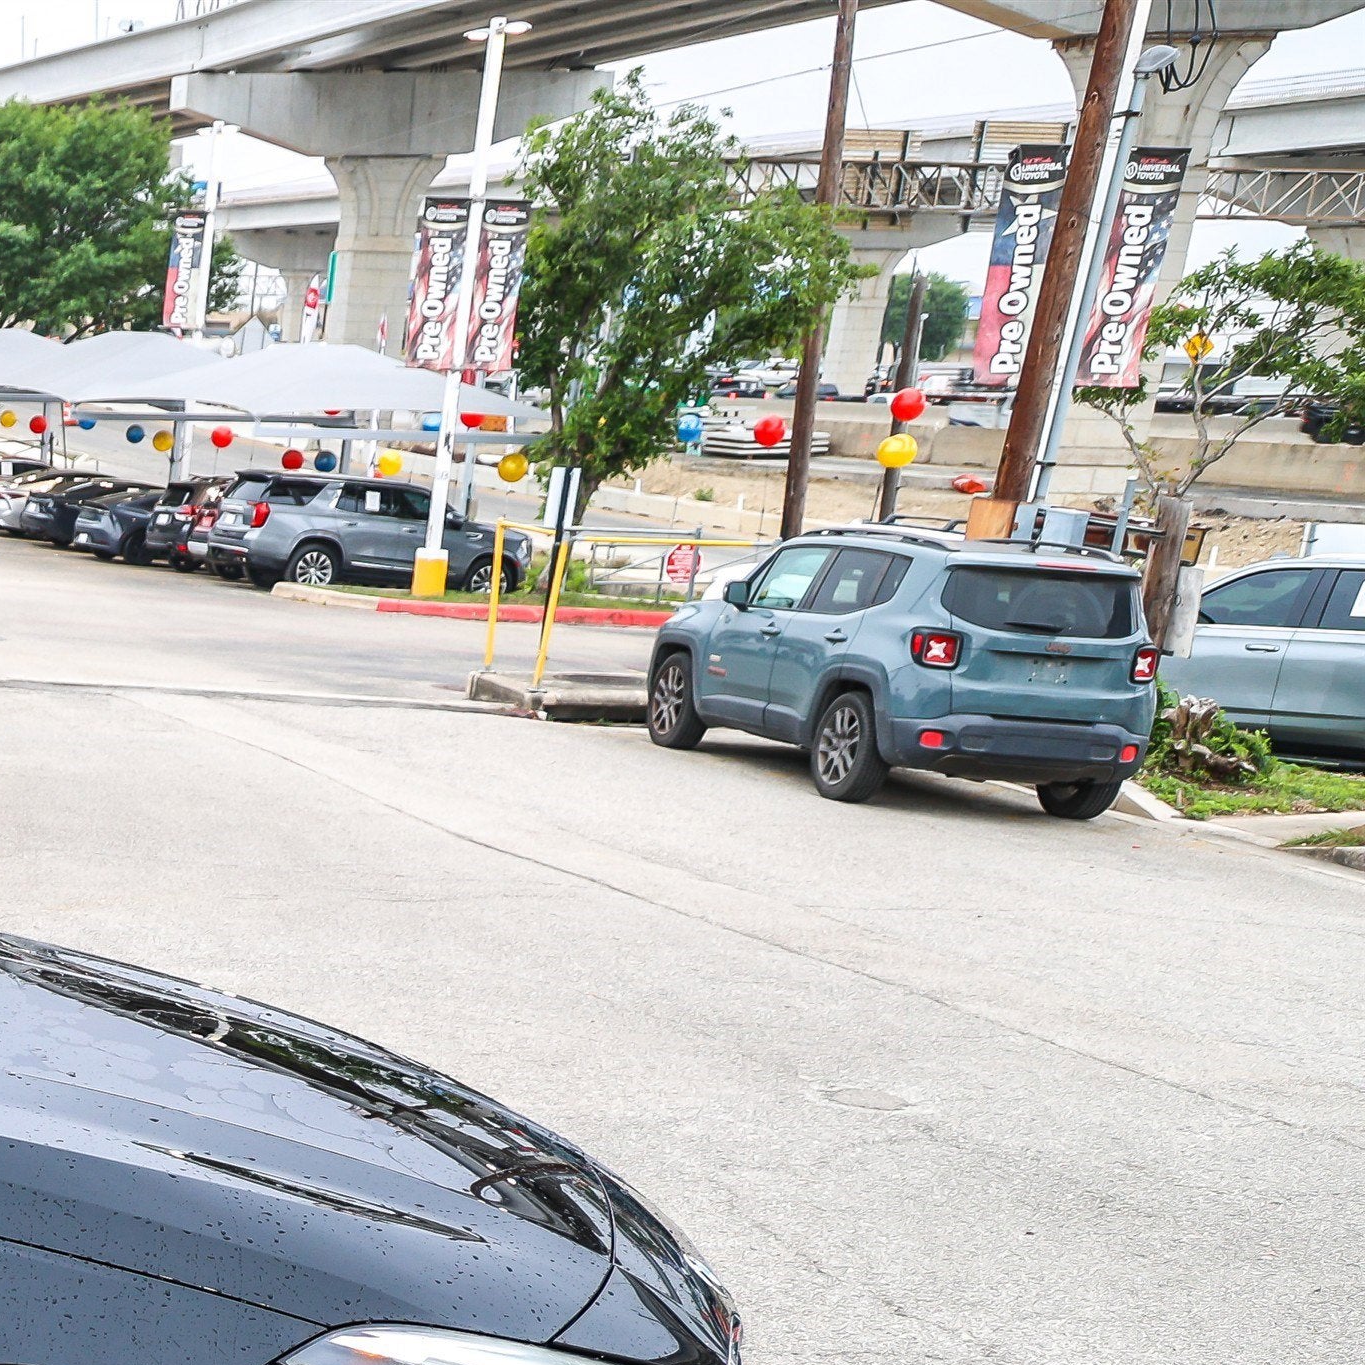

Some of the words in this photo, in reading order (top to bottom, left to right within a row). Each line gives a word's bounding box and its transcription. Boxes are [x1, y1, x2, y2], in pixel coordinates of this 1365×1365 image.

[1021, 171, 1050, 180] TOYOTA
[1022, 162, 1064, 172] UNIVERSAL
[1136, 172, 1165, 180] TOYOTA
[1138, 164, 1181, 173] UNIVERSAL
[173, 238, 195, 295] Owned
[420, 237, 453, 318] Owned
[479, 239, 512, 320] Owned
[999, 204, 1042, 316] Owned
[1102, 204, 1154, 316] Owned
